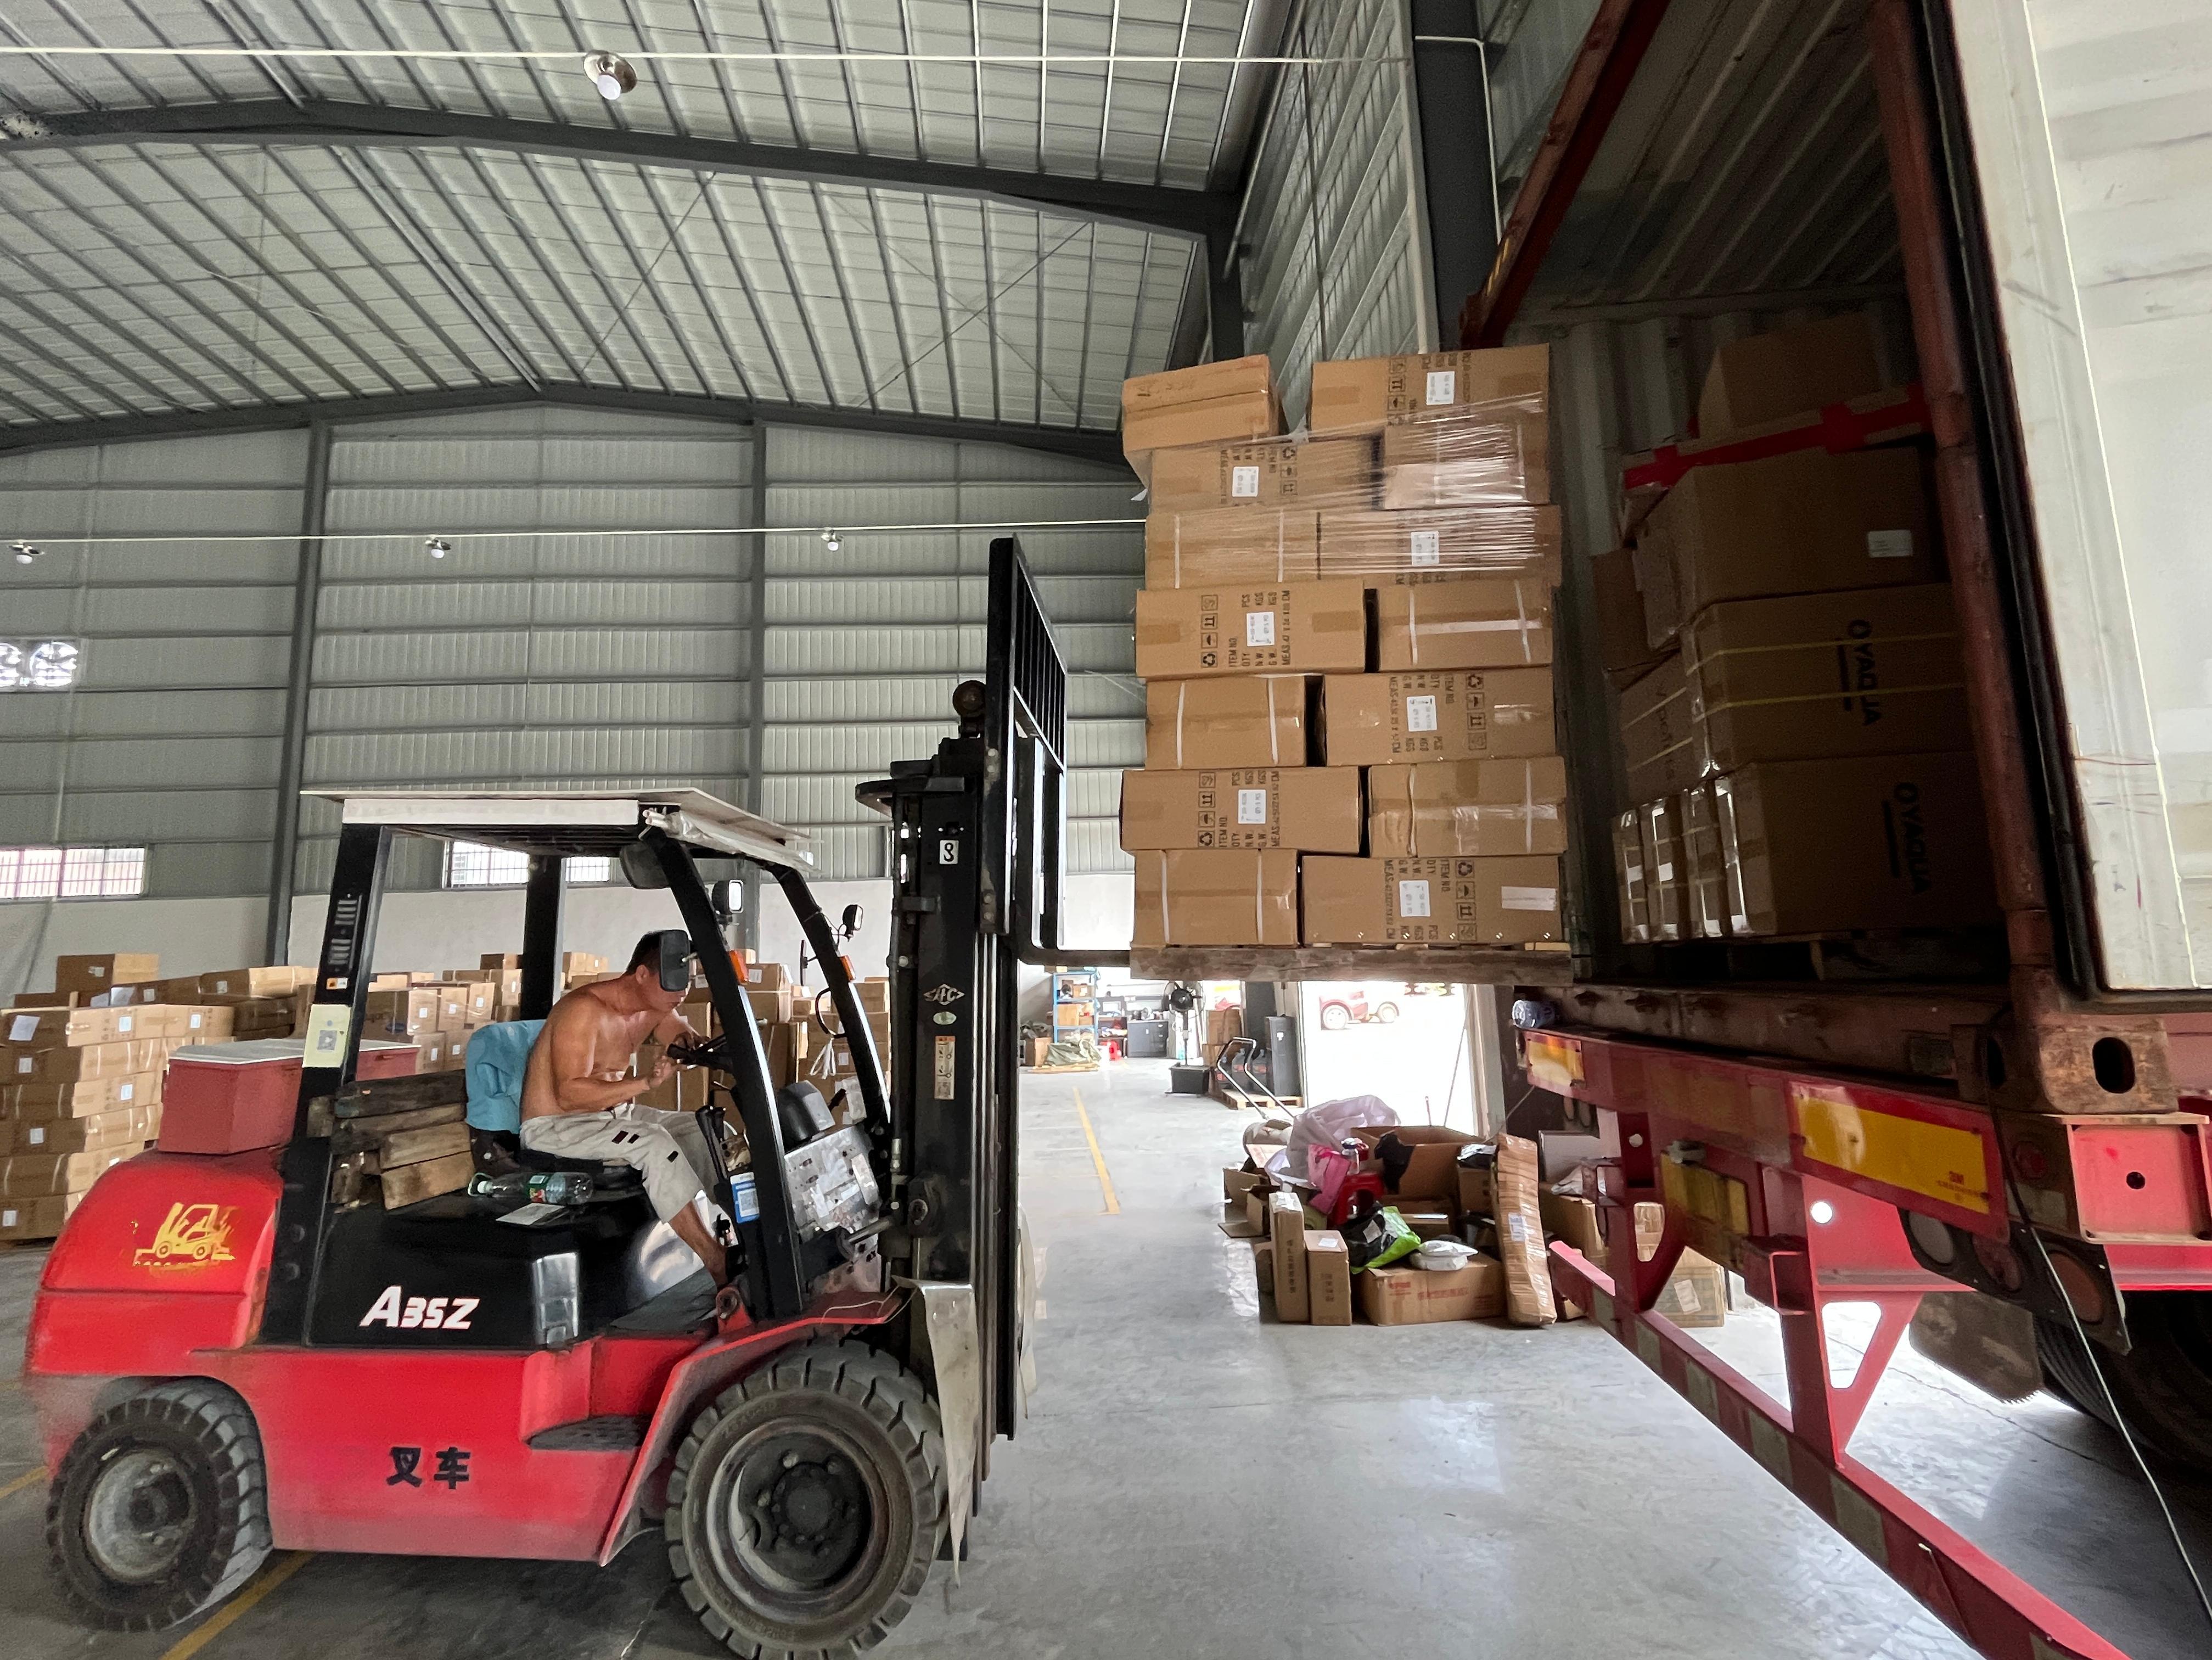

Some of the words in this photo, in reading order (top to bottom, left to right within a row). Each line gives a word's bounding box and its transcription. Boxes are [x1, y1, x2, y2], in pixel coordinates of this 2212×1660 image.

[1242, 594, 1250, 608] PCS
[1282, 590, 1290, 601] CM
[1228, 649, 1237, 667] ITEM
[1232, 772, 1240, 786] PCS
[1245, 771, 1254, 784] KGS
[1258, 770, 1266, 784] KGS
[1271, 771, 1279, 781] CM
[1219, 829, 1227, 847] ITEM
[1441, 860, 1450, 878] ITEM
[1386, 928, 1395, 939] CM
[1414, 926, 1423, 940] KGS
[1429, 925, 1438, 940] PCS
[359, 1285, 480, 1330] A35Z
[386, 1446, 471, 1489] 叉车
